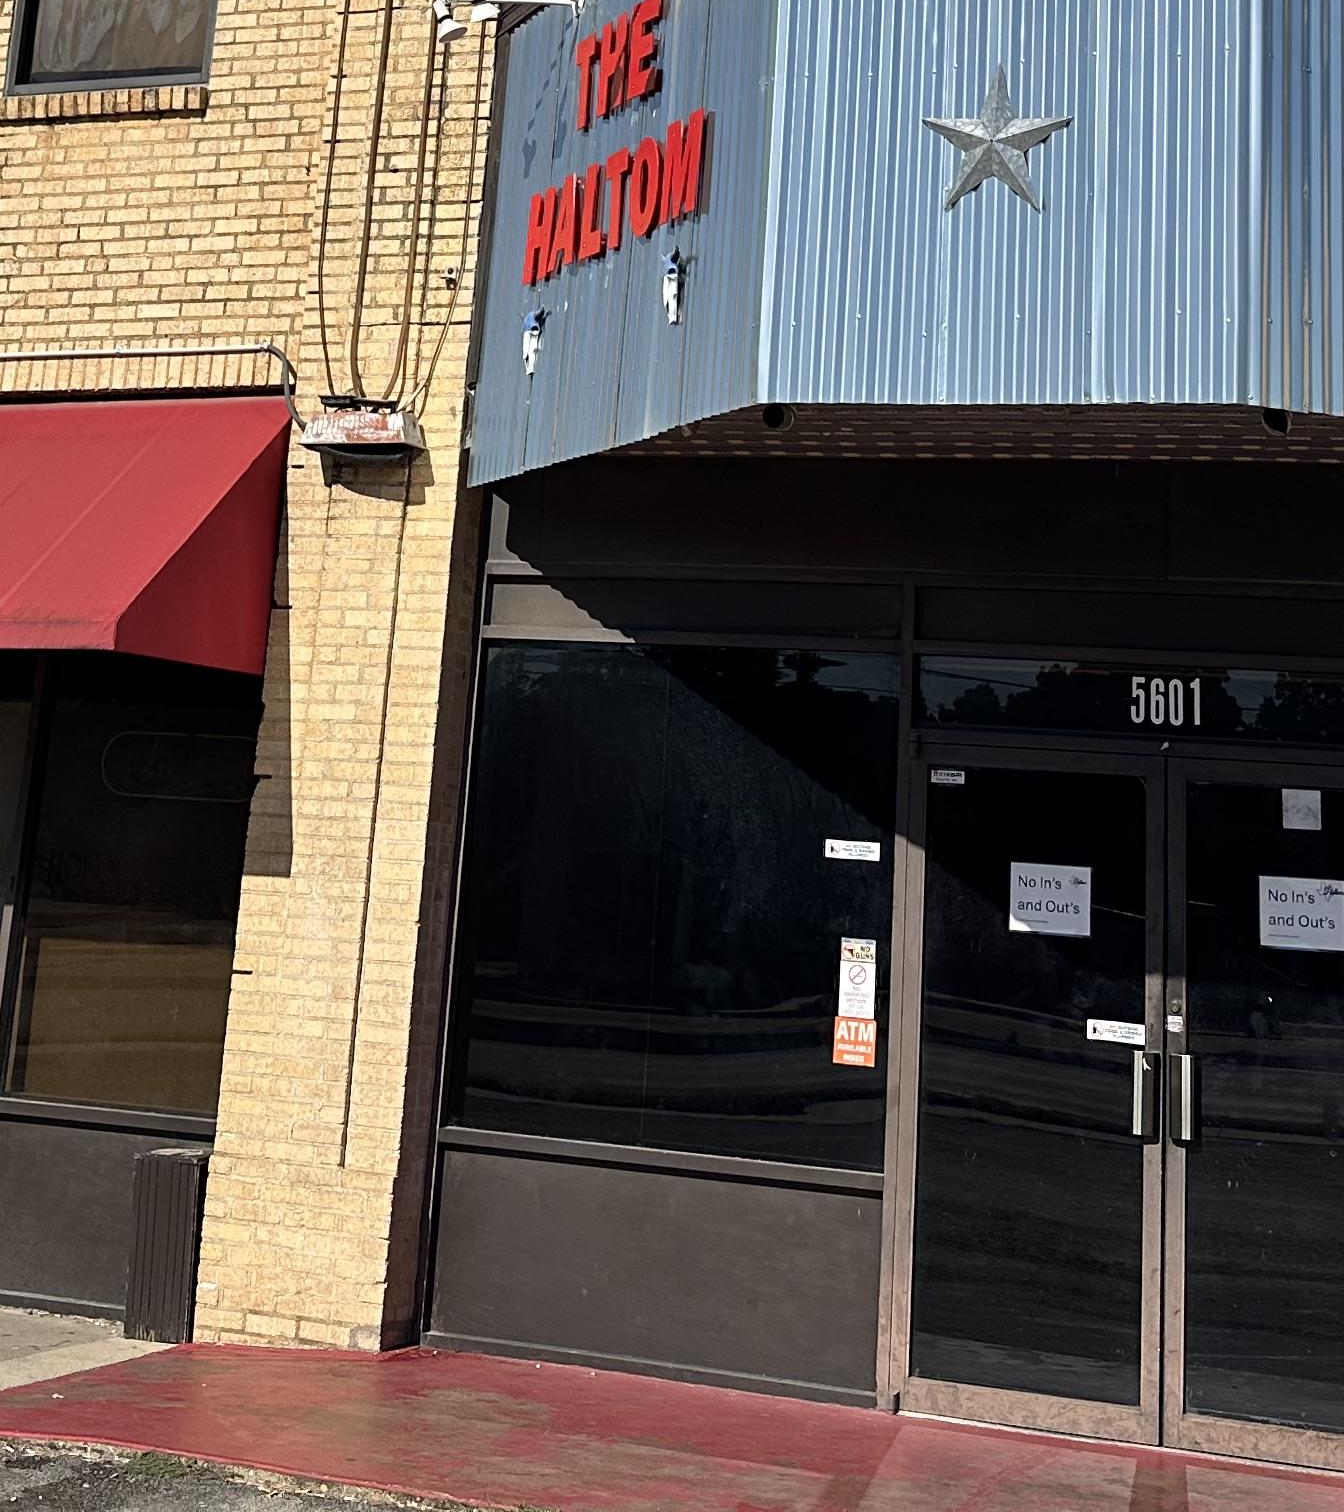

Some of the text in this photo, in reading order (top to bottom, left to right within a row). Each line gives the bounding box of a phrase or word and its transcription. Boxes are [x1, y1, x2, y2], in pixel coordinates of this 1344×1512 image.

[521, 107, 705, 286] HALTOM
[1130, 676, 1201, 726] 5601
[1018, 874, 1037, 888] No
[1040, 876, 1062, 890] In's
[1268, 888, 1288, 902] No
[1292, 890, 1315, 904] In's
[1018, 900, 1080, 914] and Out's
[1268, 915, 1336, 929] and Out's
[836, 1020, 875, 1043] ATM
